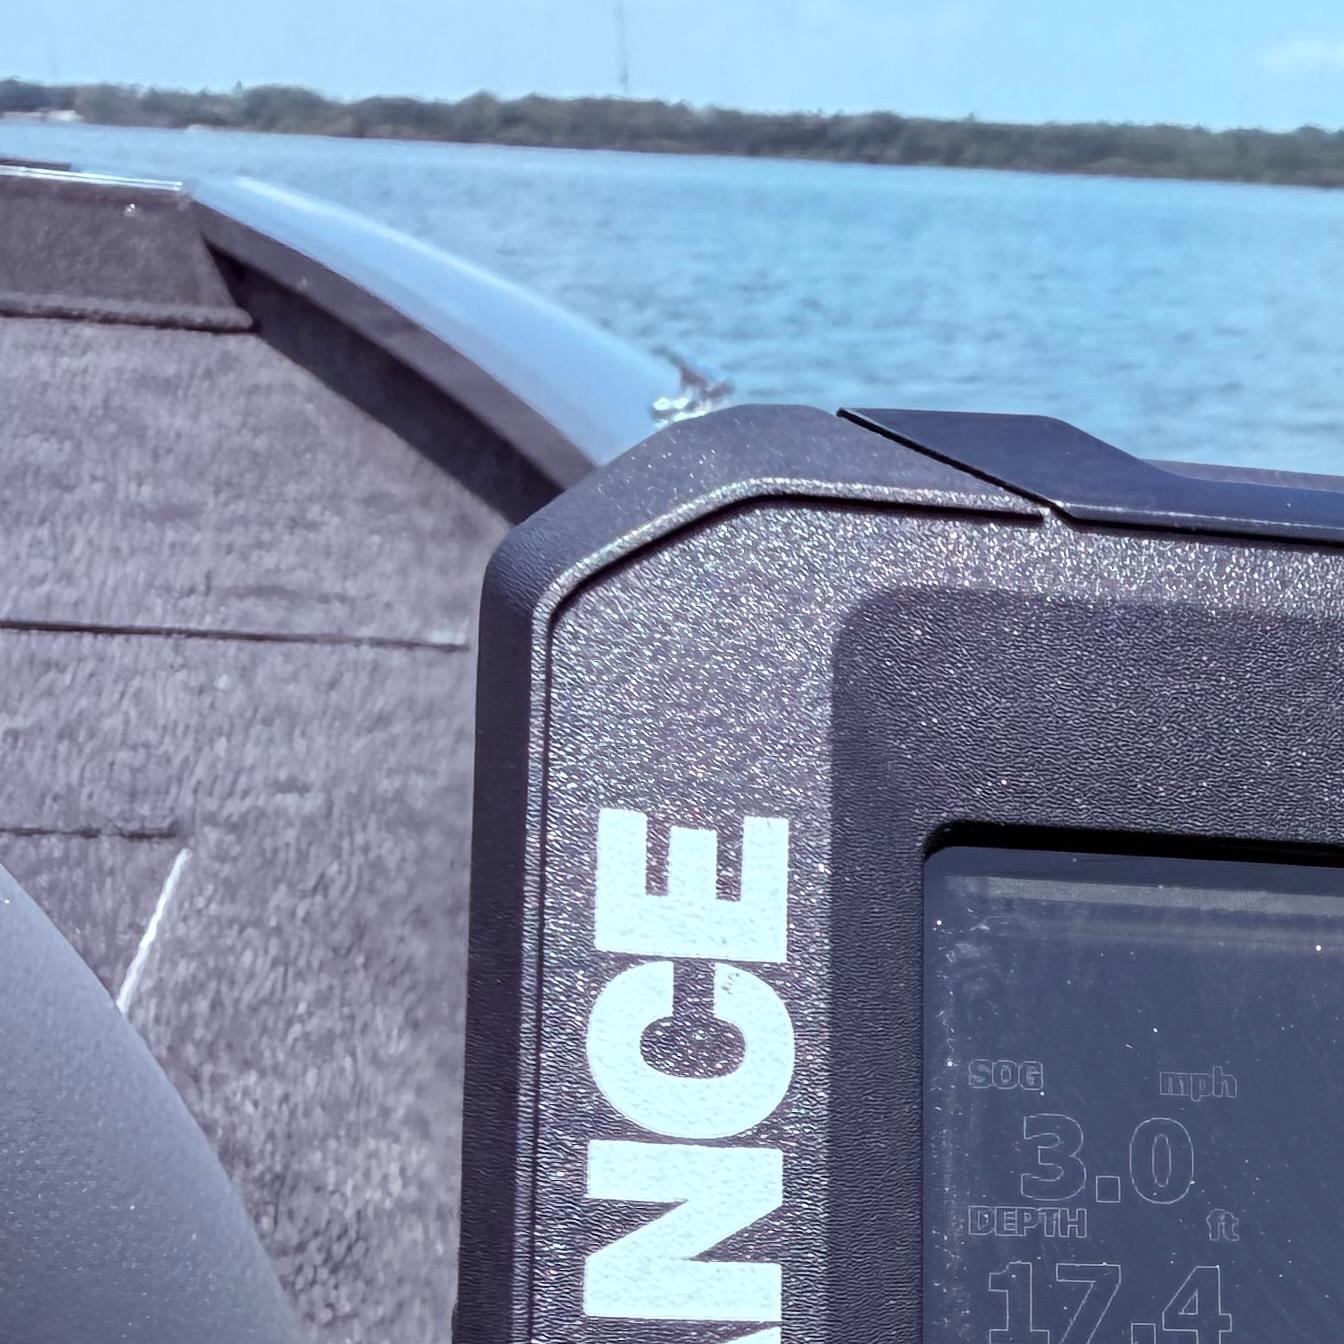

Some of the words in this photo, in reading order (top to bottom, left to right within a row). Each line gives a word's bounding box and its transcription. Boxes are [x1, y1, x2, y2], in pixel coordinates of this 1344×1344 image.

[967, 1058, 1045, 1091] SOG
[1159, 1066, 1239, 1102] mph
[1018, 1112, 1195, 1205] 3.0
[967, 1205, 1088, 1239] DEPTH
[1205, 1208, 1240, 1242] ft
